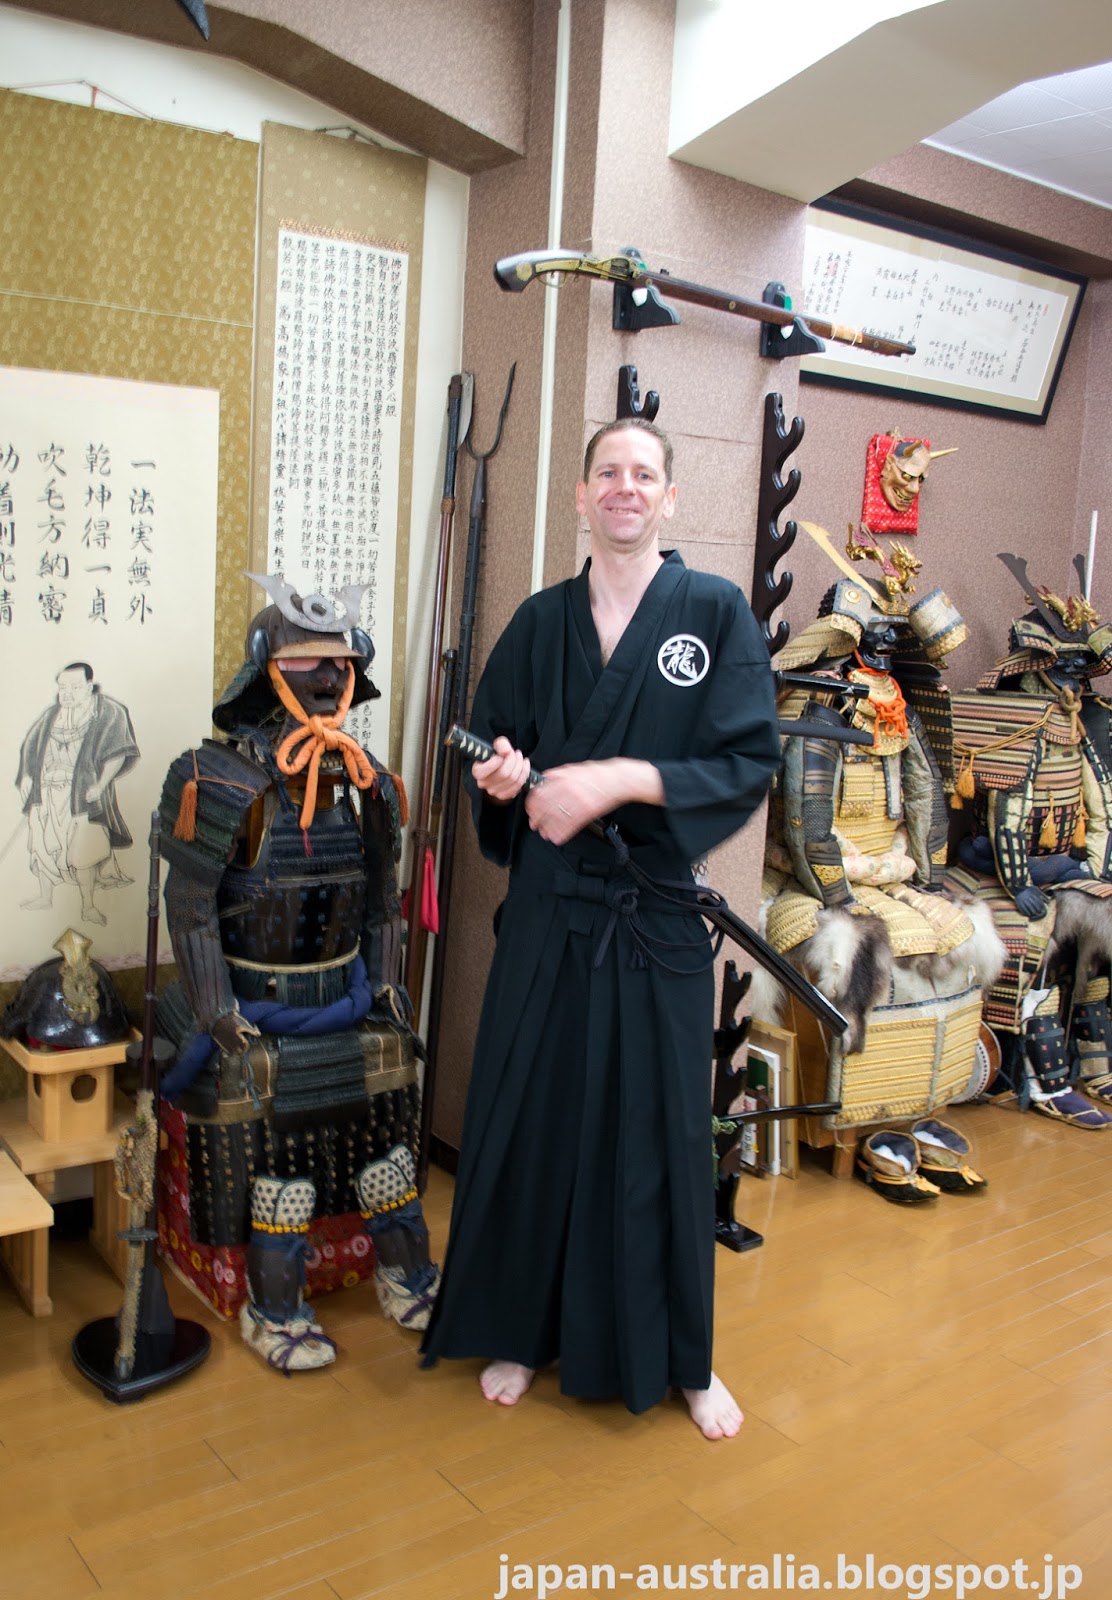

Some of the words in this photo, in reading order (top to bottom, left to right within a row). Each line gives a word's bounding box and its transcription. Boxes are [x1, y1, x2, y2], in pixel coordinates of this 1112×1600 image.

[126, 457, 157, 625] 一法実無外
